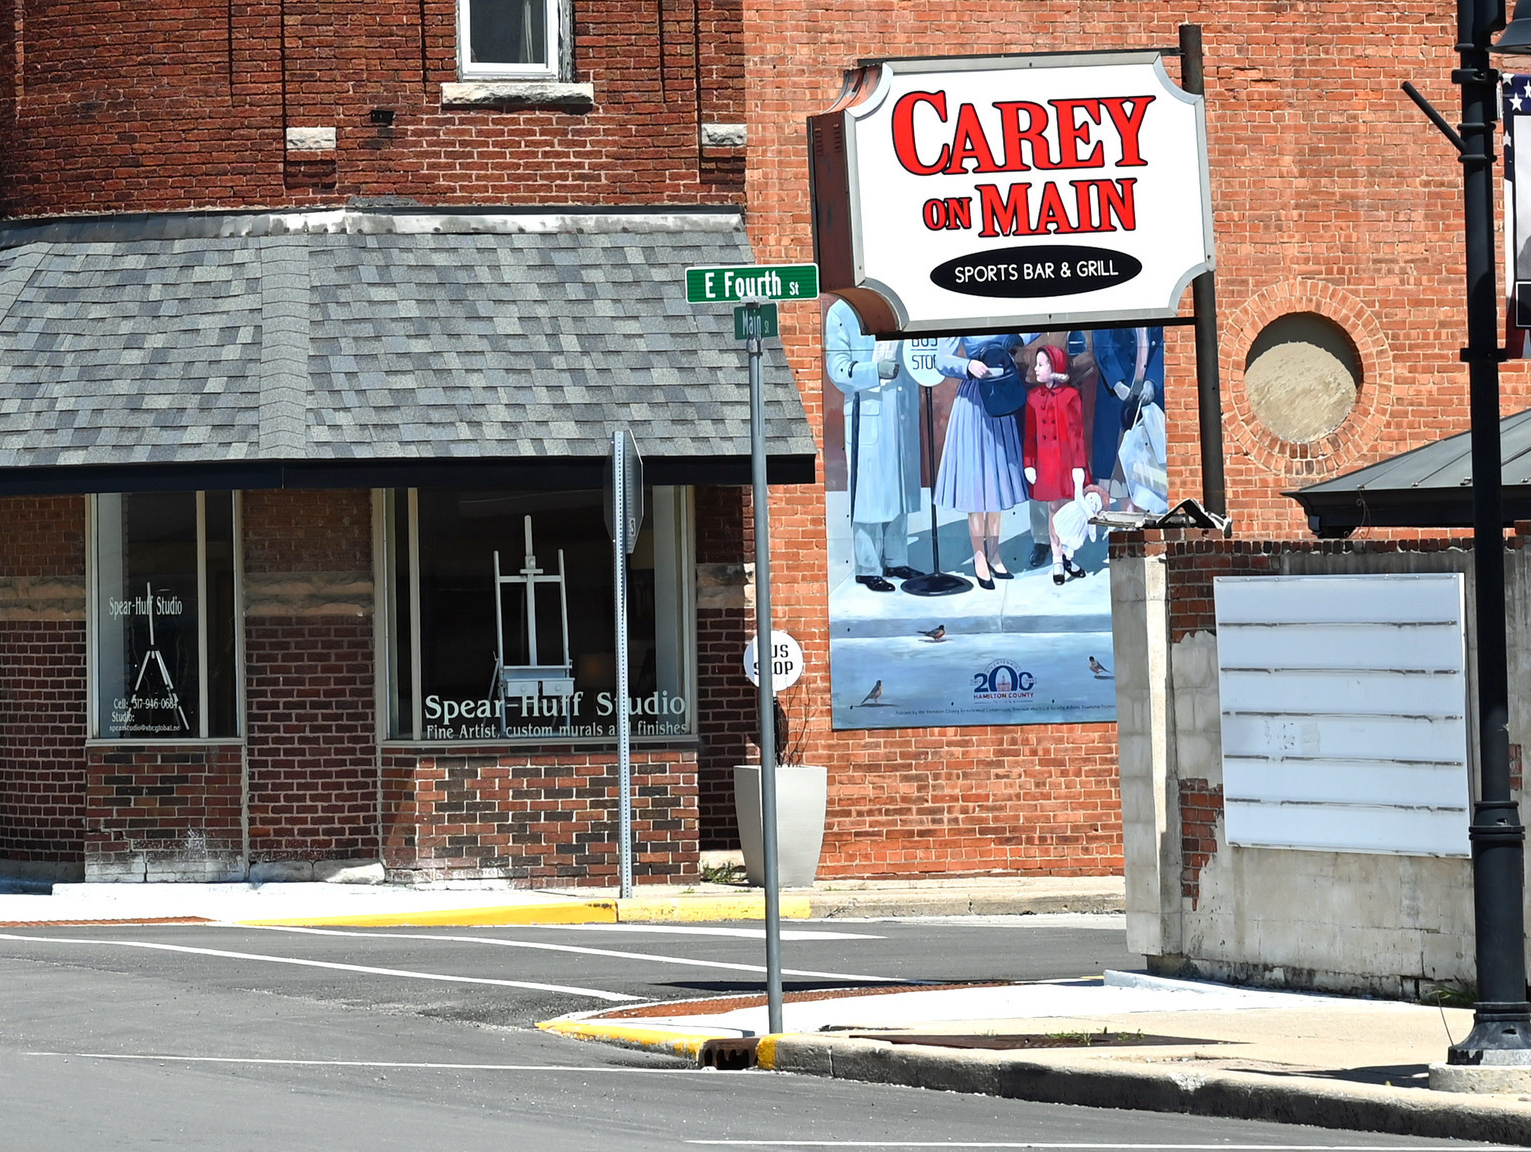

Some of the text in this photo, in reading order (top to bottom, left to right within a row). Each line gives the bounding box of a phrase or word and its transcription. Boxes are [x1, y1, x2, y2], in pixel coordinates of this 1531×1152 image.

[891, 90, 1156, 176] CAREY
[922, 178, 1138, 237] ON MAIN
[705, 270, 799, 298] E Fourth St
[954, 259, 1119, 283] SPORTS BAR & GRILL
[742, 310, 762, 339] Main
[156, 595, 183, 616] Studio
[771, 644, 789, 658] US
[753, 660, 794, 675] SOP
[424, 692, 583, 725] Spear-Huff
[427, 725, 454, 739] Fine
[459, 724, 501, 739] Artist,
[506, 724, 553, 738] custom
[559, 723, 603, 737] murals
[637, 720, 687, 735] finishes
